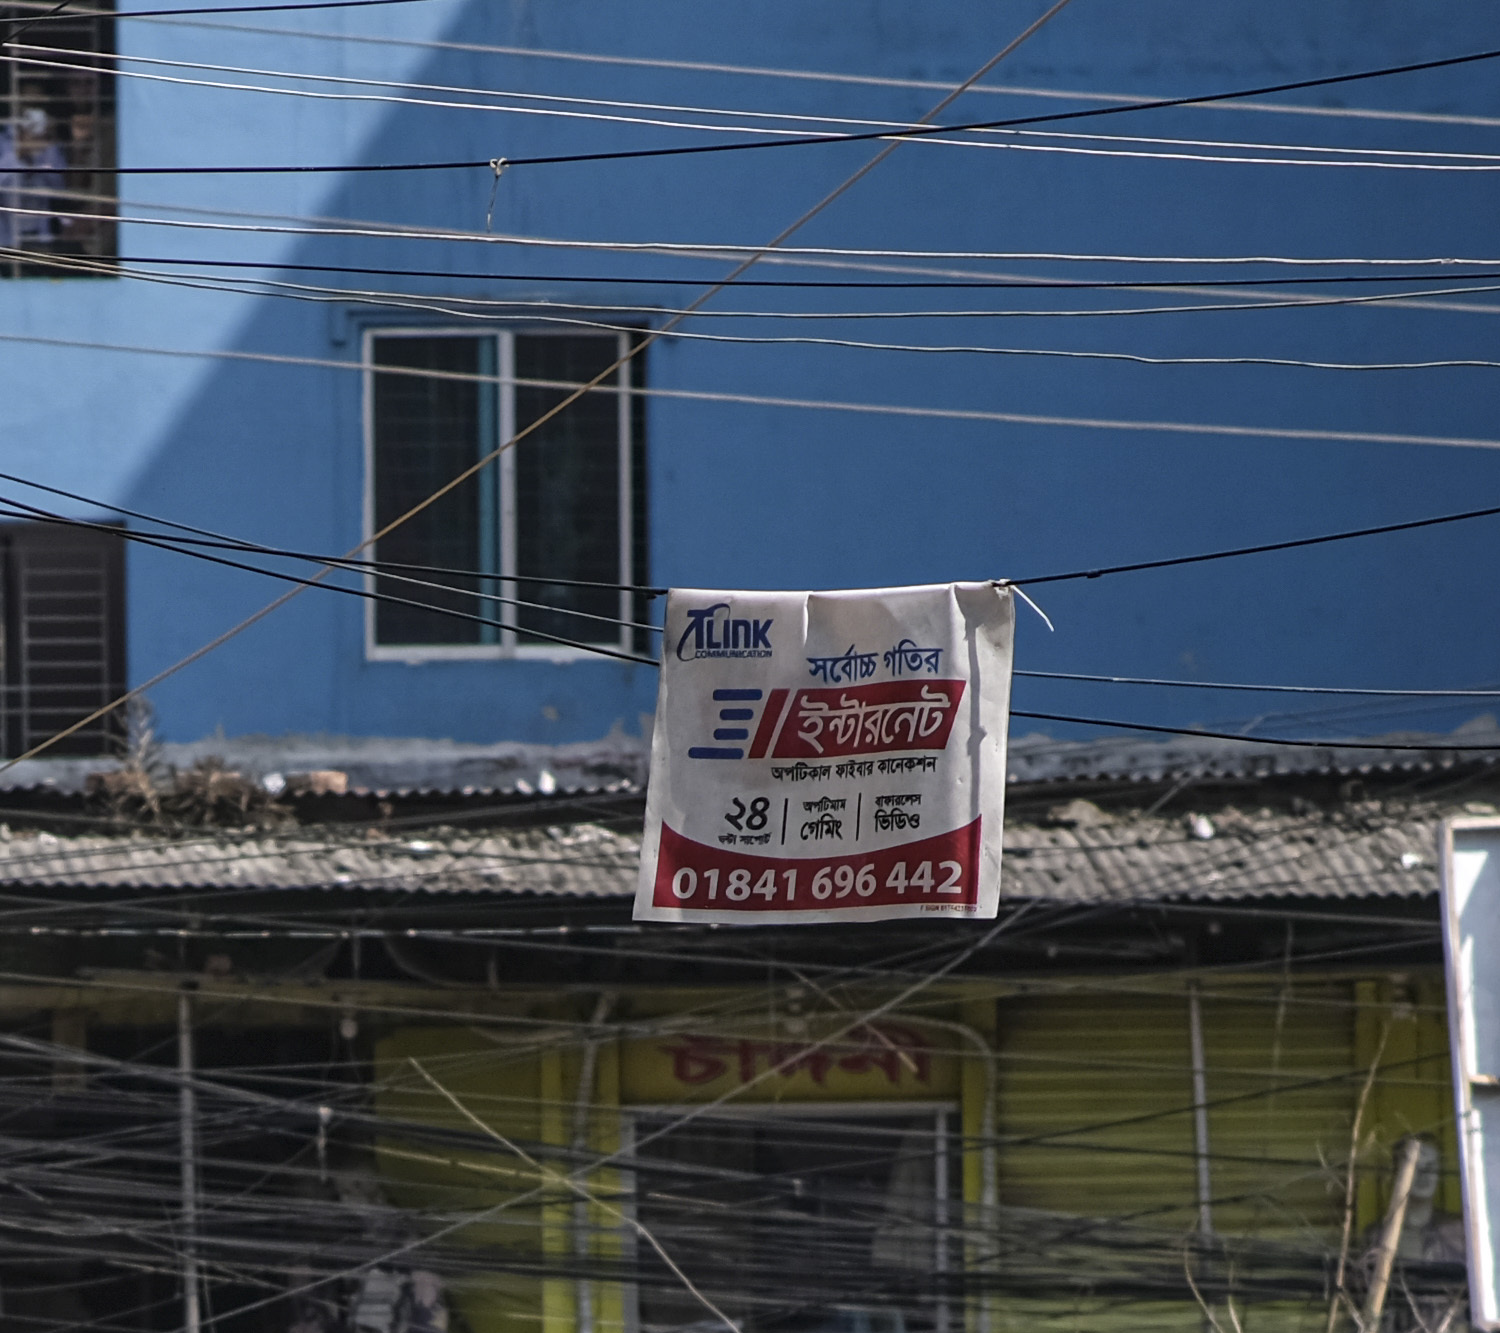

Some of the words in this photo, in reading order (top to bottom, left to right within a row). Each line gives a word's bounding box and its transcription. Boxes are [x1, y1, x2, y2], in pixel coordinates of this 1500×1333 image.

[694, 649, 773, 658] COMMUNICATION
[806, 644, 878, 684] সর্বোচ্চ
[884, 639, 943, 674] গতির
[797, 685, 950, 753] ইন্টারনেট
[835, 759, 874, 780] ফাইবার
[878, 755, 937, 775] কানেকশন
[724, 797, 770, 831] ২৪
[800, 813, 843, 840] গেমিং
[875, 808, 920, 832] ভিডিও
[672, 866, 797, 901] 01841
[811, 864, 876, 900] 696
[886, 860, 962, 895] 442
